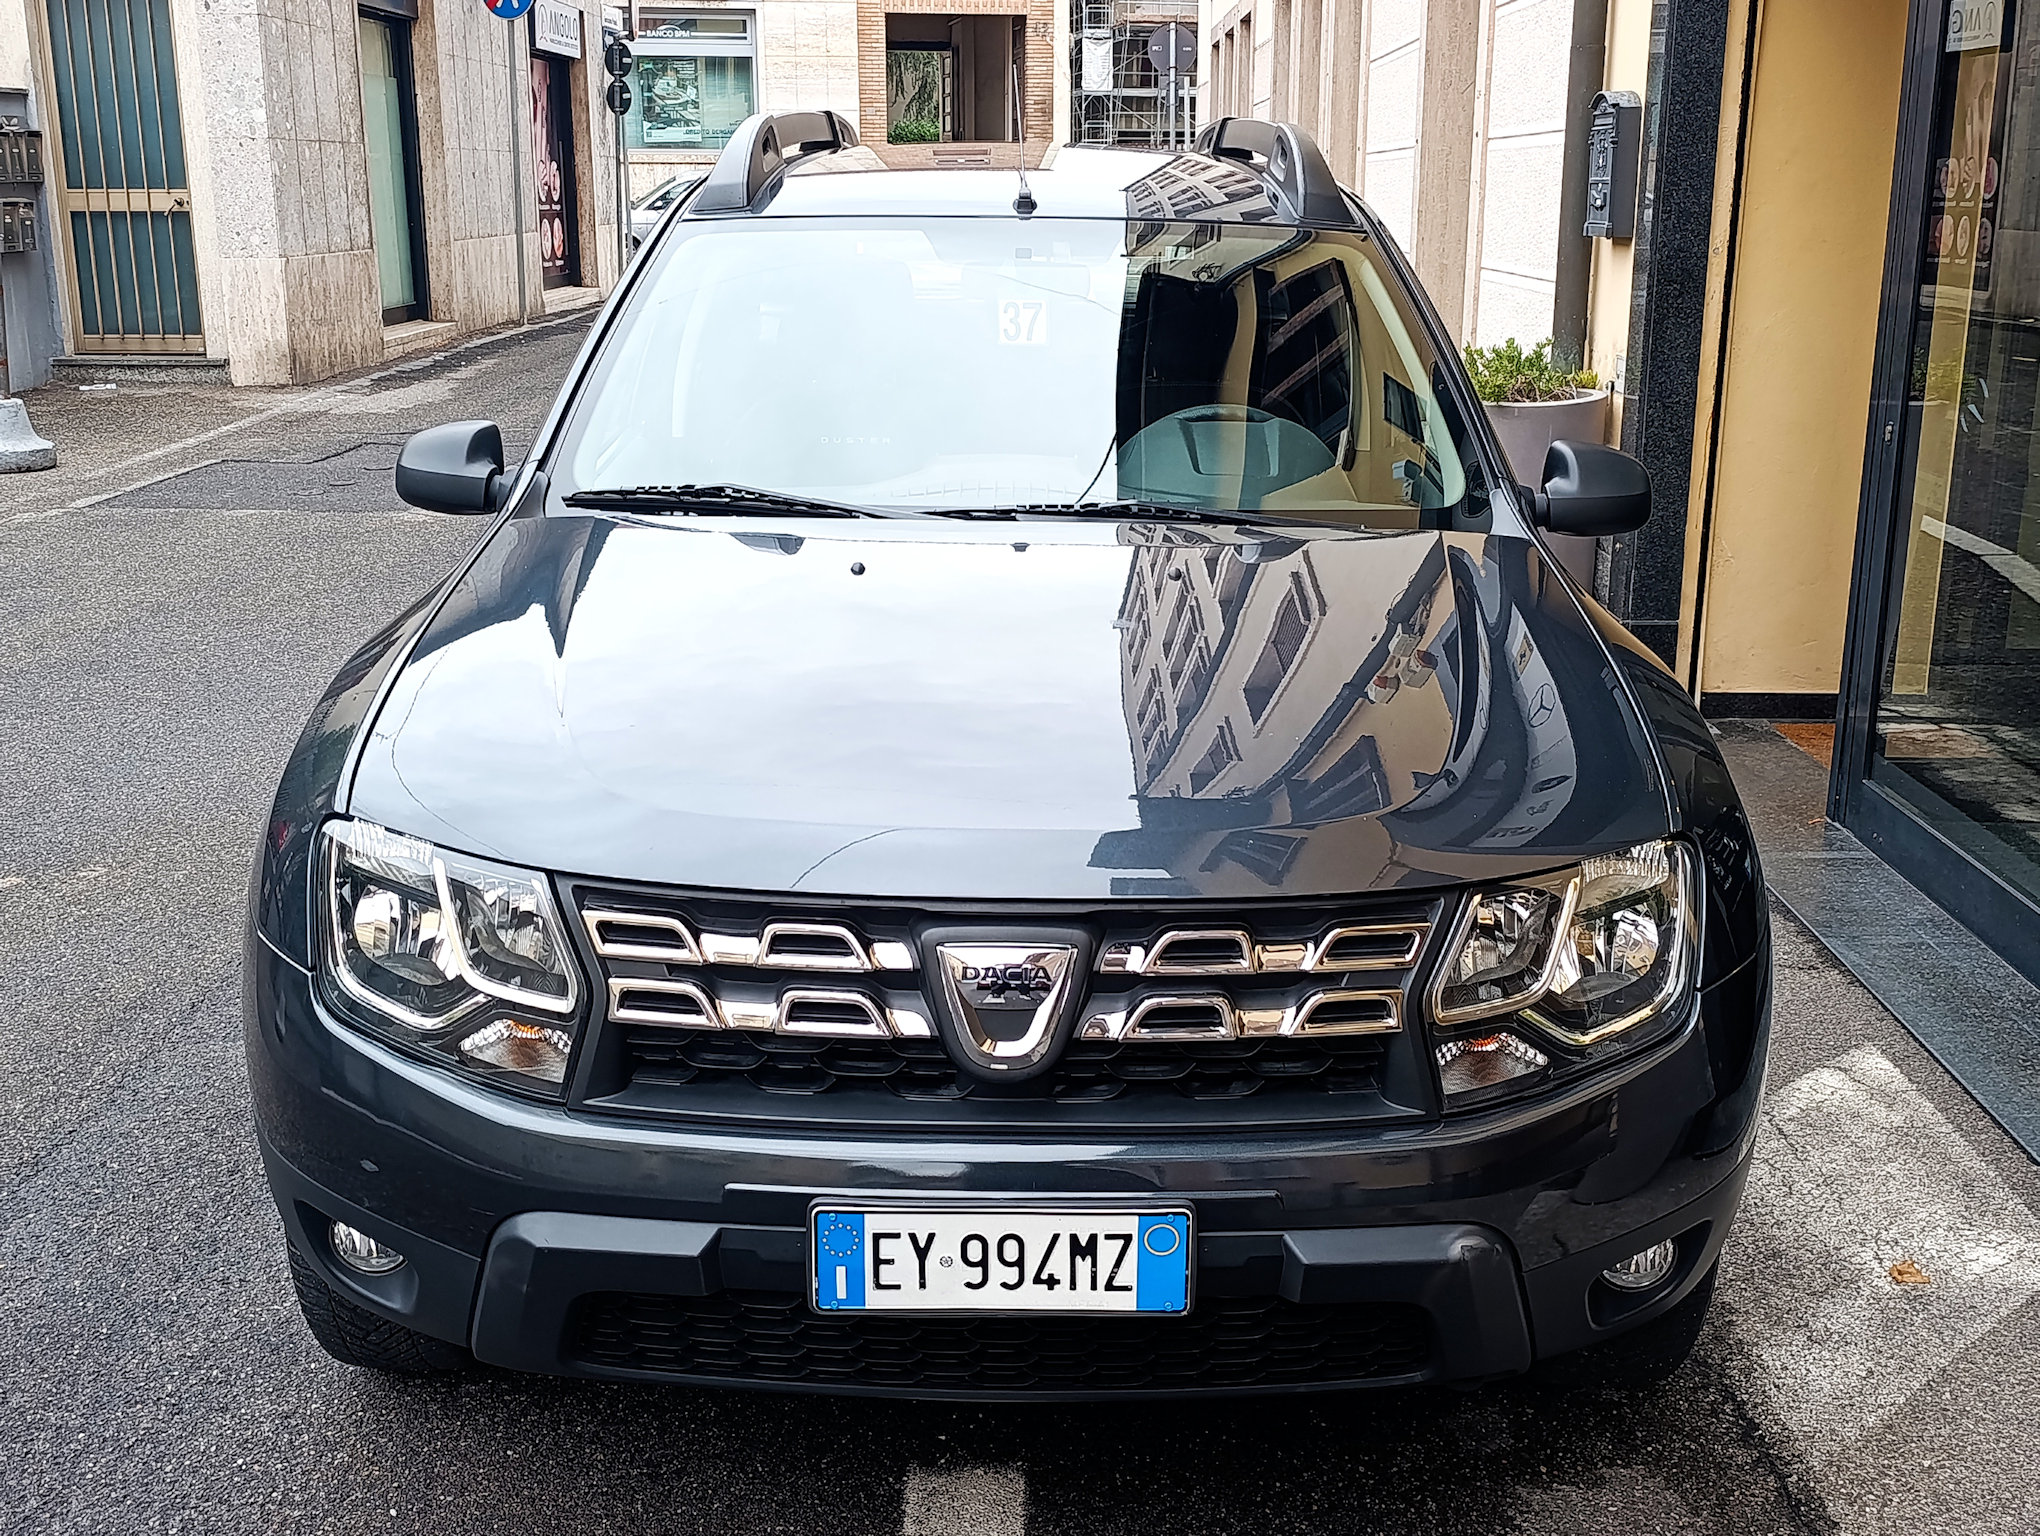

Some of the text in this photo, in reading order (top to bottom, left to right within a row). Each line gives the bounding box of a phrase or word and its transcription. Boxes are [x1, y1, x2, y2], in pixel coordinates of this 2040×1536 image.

[549, 9, 578, 41] ANGOLO
[646, 29, 690, 38] BANCO BPM
[1003, 301, 1042, 341] 37
[820, 435, 891, 444] DUSTER
[961, 966, 1051, 983] DACIA
[872, 1232, 1134, 1292] EY 994MZ
